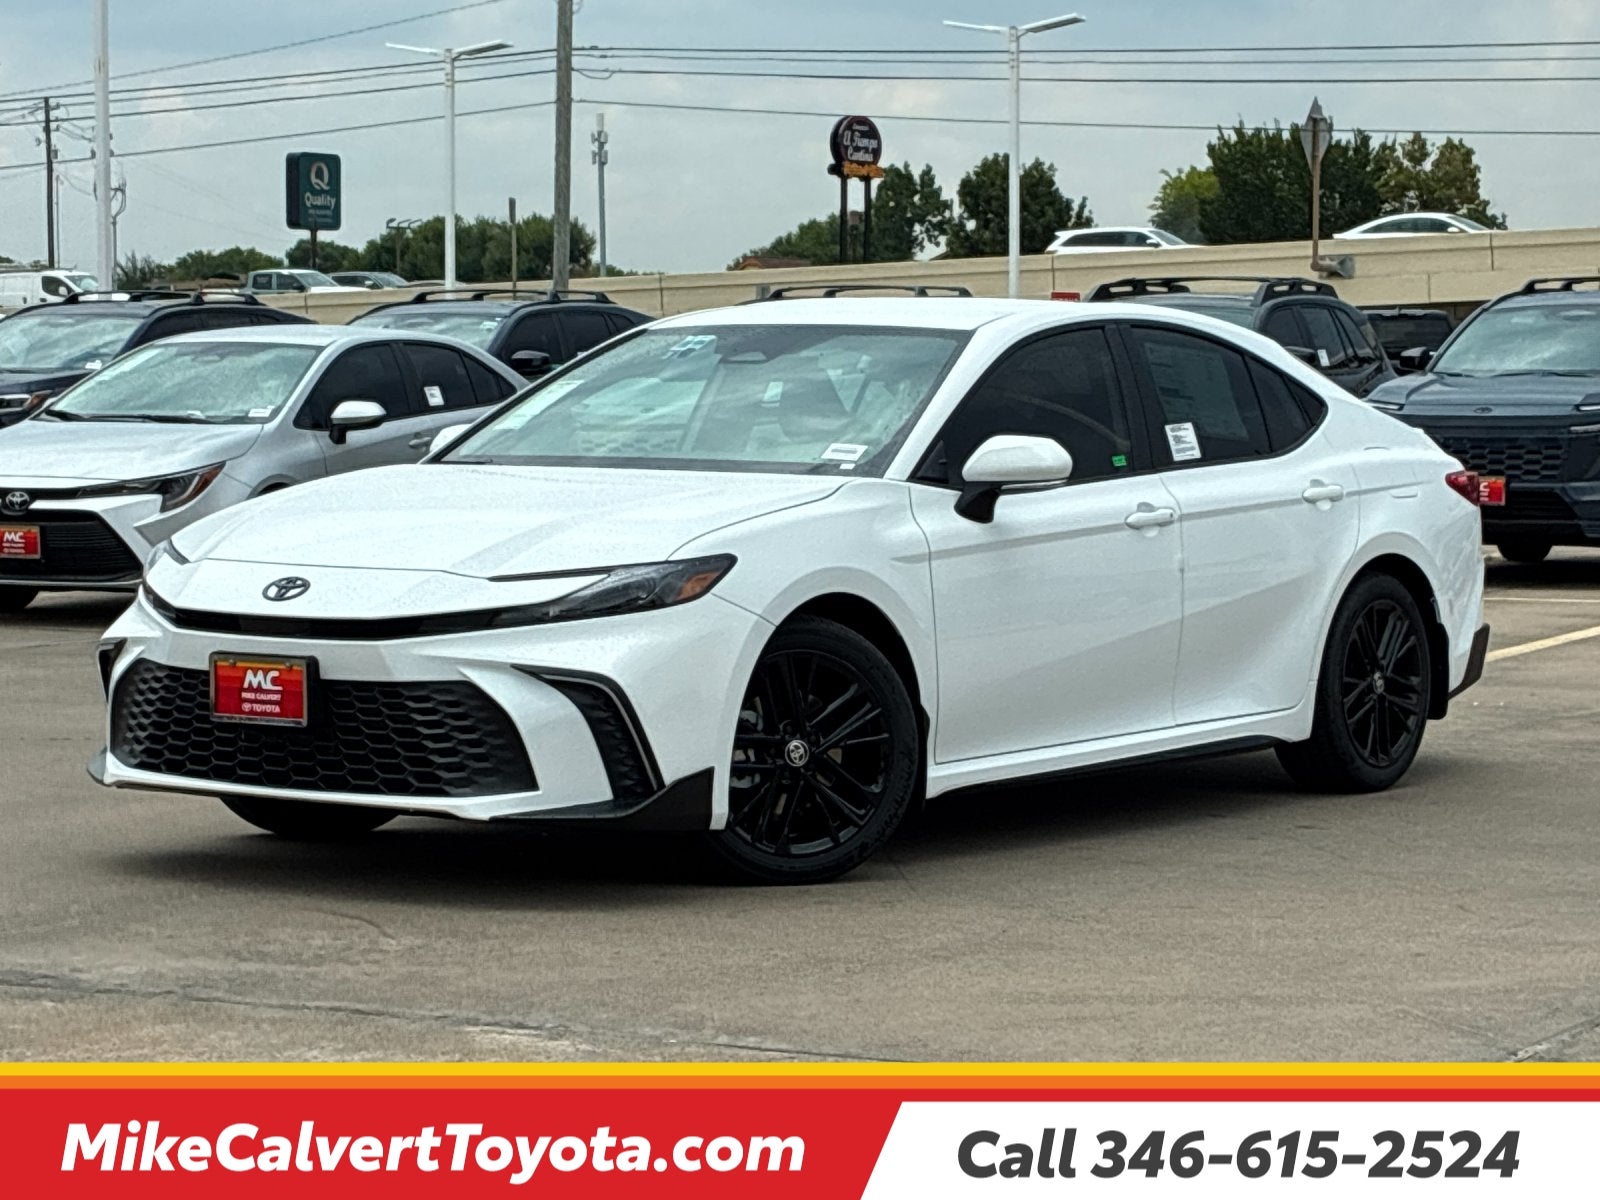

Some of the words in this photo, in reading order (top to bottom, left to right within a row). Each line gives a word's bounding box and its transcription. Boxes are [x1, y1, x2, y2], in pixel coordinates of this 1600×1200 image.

[310, 161, 330, 191] Q
[304, 191, 336, 211] Quality
[3, 531, 26, 543] MC
[243, 669, 284, 691] MC
[256, 693, 282, 701] CALVERT
[252, 703, 281, 713] TOYOTA
